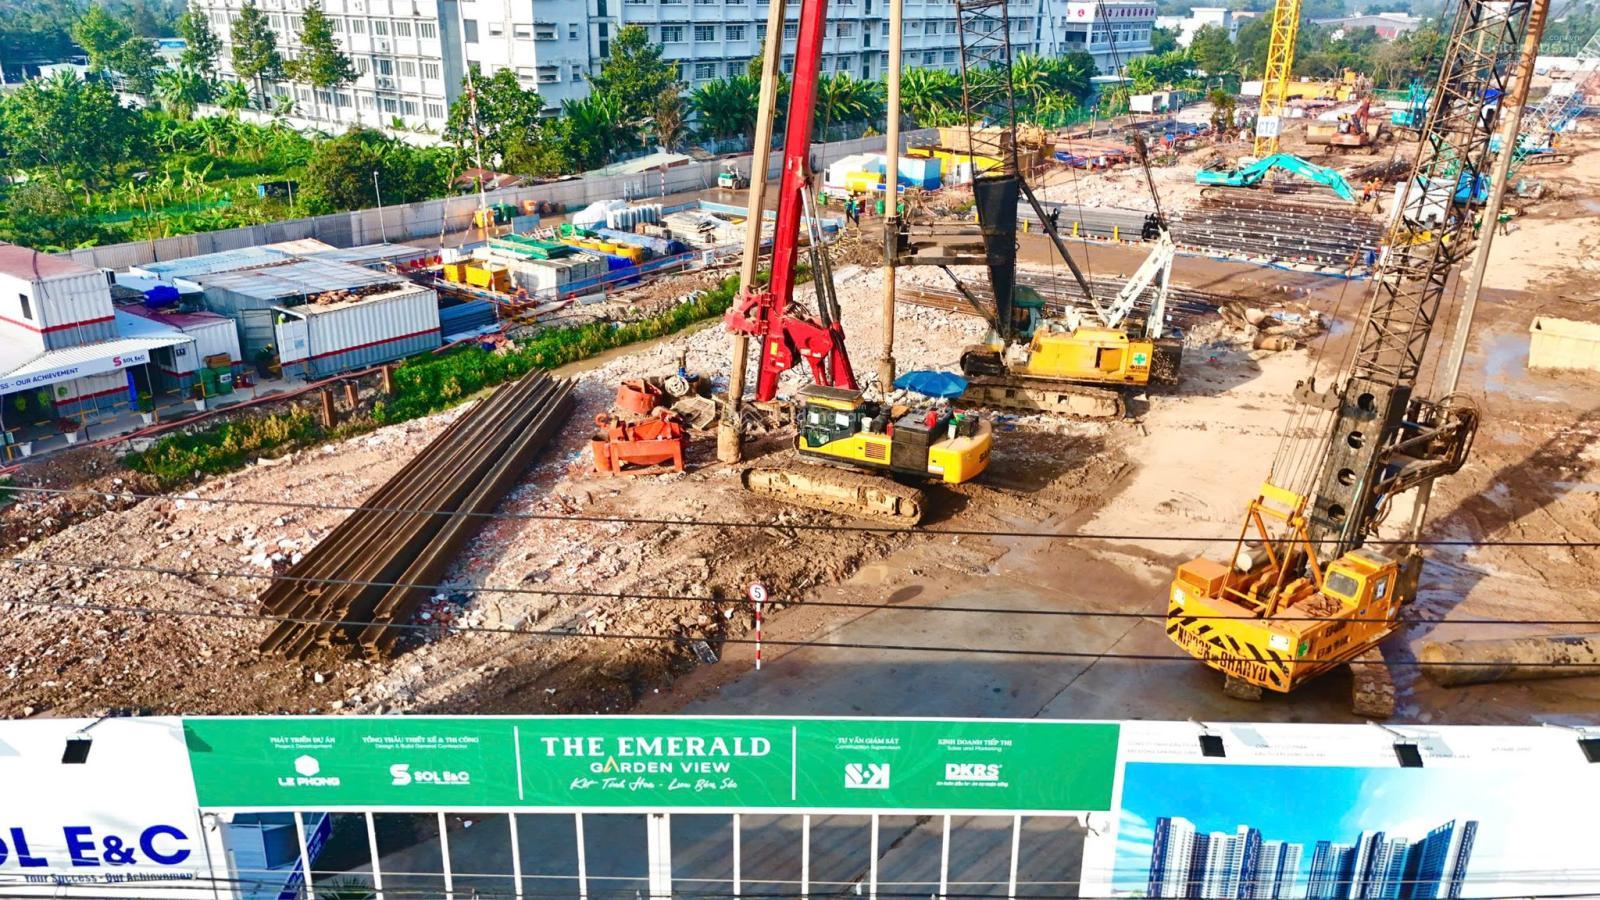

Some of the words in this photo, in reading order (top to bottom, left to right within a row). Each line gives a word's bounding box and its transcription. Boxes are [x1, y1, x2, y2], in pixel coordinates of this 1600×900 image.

[16, 378, 31, 386] OUR
[33, 367, 79, 383] ACHIEVEMENT
[754, 587, 761, 598] 5
[540, 737, 605, 757] THE
[618, 737, 771, 757] EMERALD
[590, 756, 673, 773] GARDEN
[680, 762, 731, 773] VIEW
[945, 763, 999, 780] DKRS
[414, 771, 441, 783] SOL
[63, 824, 191, 867] E&C
